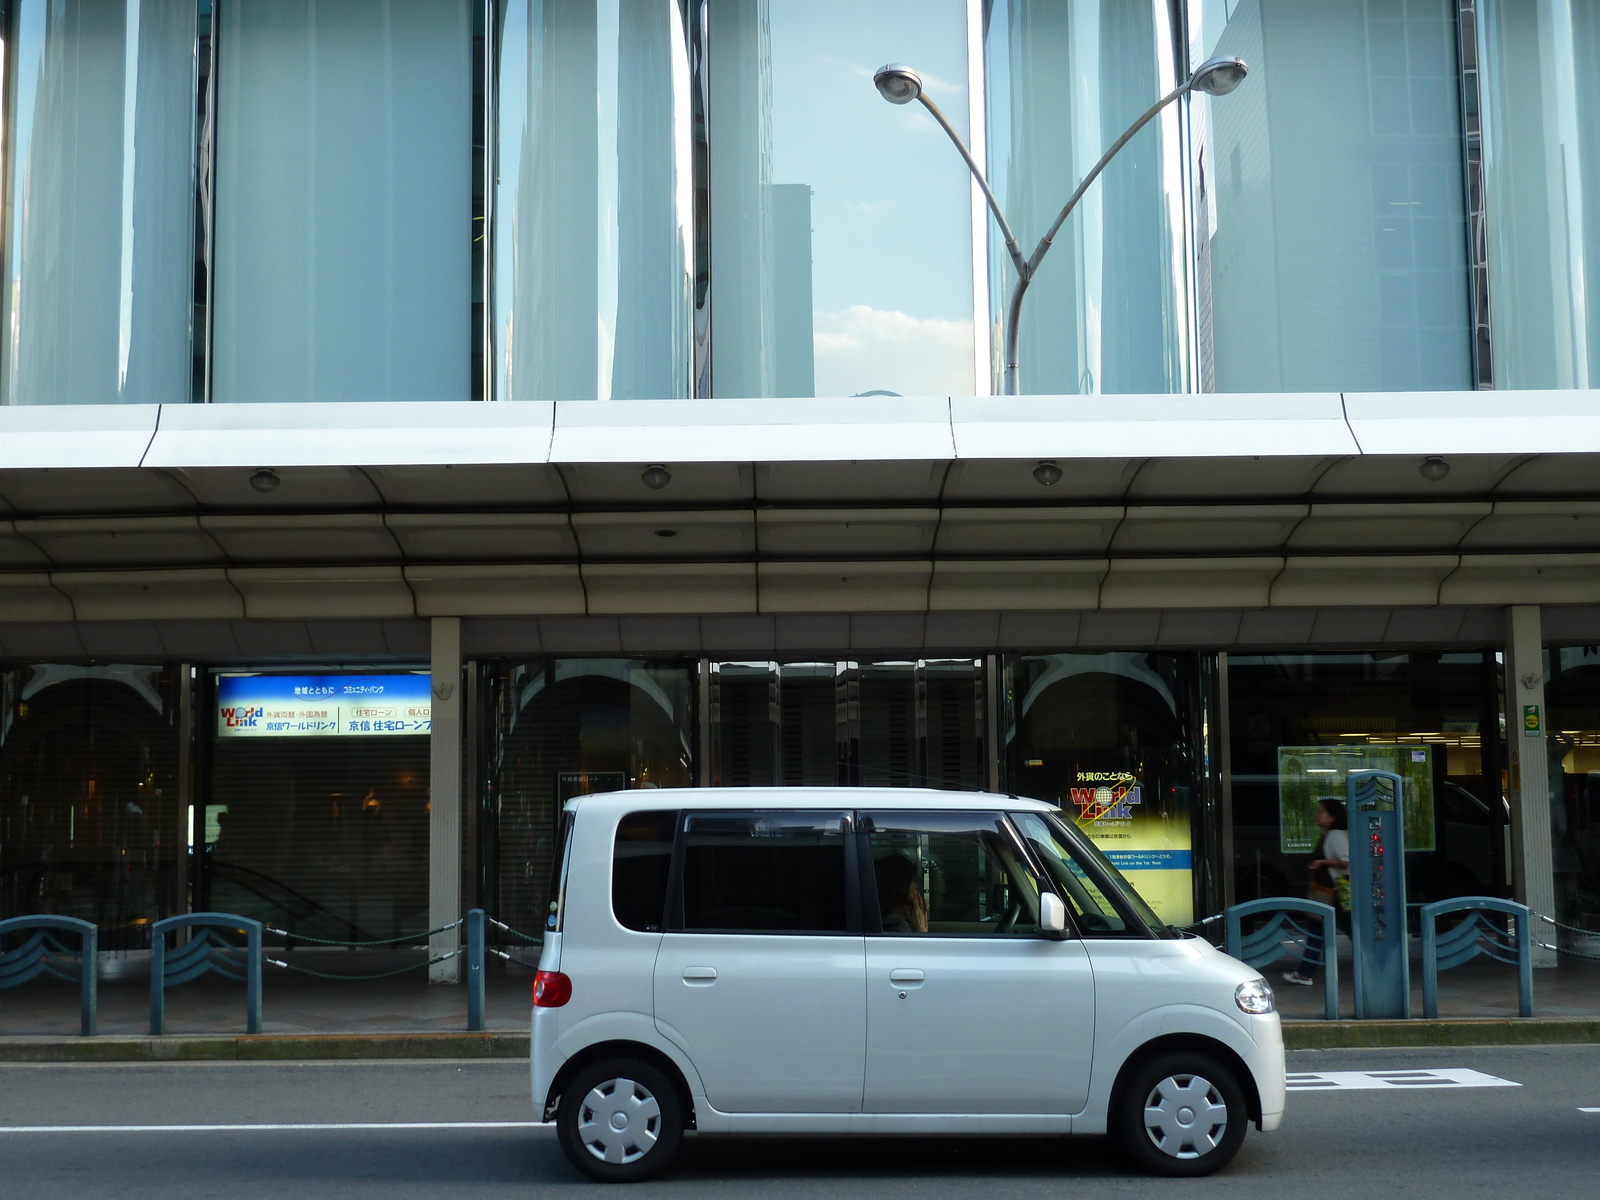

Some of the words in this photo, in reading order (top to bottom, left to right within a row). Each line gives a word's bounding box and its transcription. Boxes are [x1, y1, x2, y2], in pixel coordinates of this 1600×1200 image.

[294, 686, 335, 695] 地域とともに
[220, 706, 264, 718] World
[355, 709, 392, 717] 住宅ローン
[408, 708, 431, 716] 個人ロ
[226, 717, 258, 727] Link
[266, 721, 336, 731] 京信ワールドリンク
[349, 720, 371, 731] 京信
[1077, 772, 1133, 781] 外貨のことなら
[1070, 787, 1141, 804] World
[1081, 802, 1133, 819] Link
